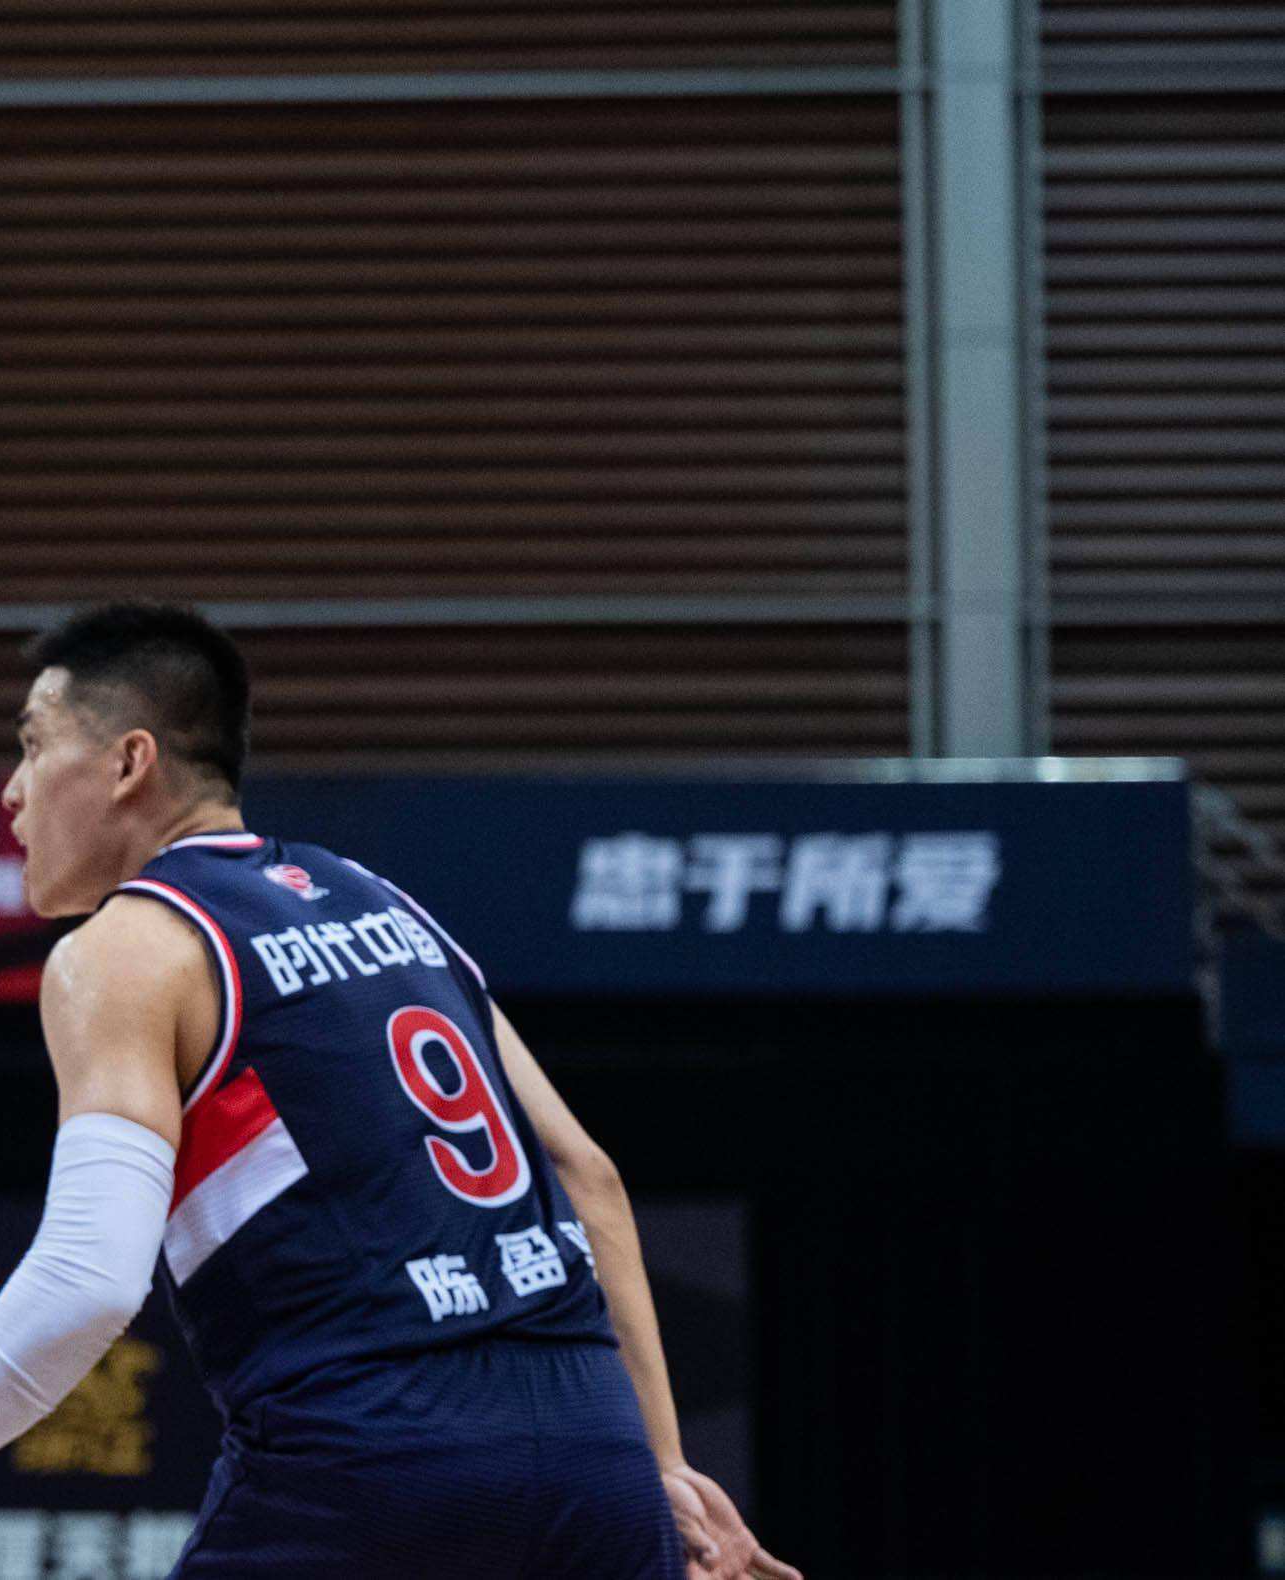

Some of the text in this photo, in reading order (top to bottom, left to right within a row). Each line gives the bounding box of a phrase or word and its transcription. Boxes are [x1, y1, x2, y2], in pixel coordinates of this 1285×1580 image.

[571, 831, 1001, 932] 忠于所爱
[386, 1005, 531, 1208] 9
[405, 1220, 597, 1322] 陈盈
